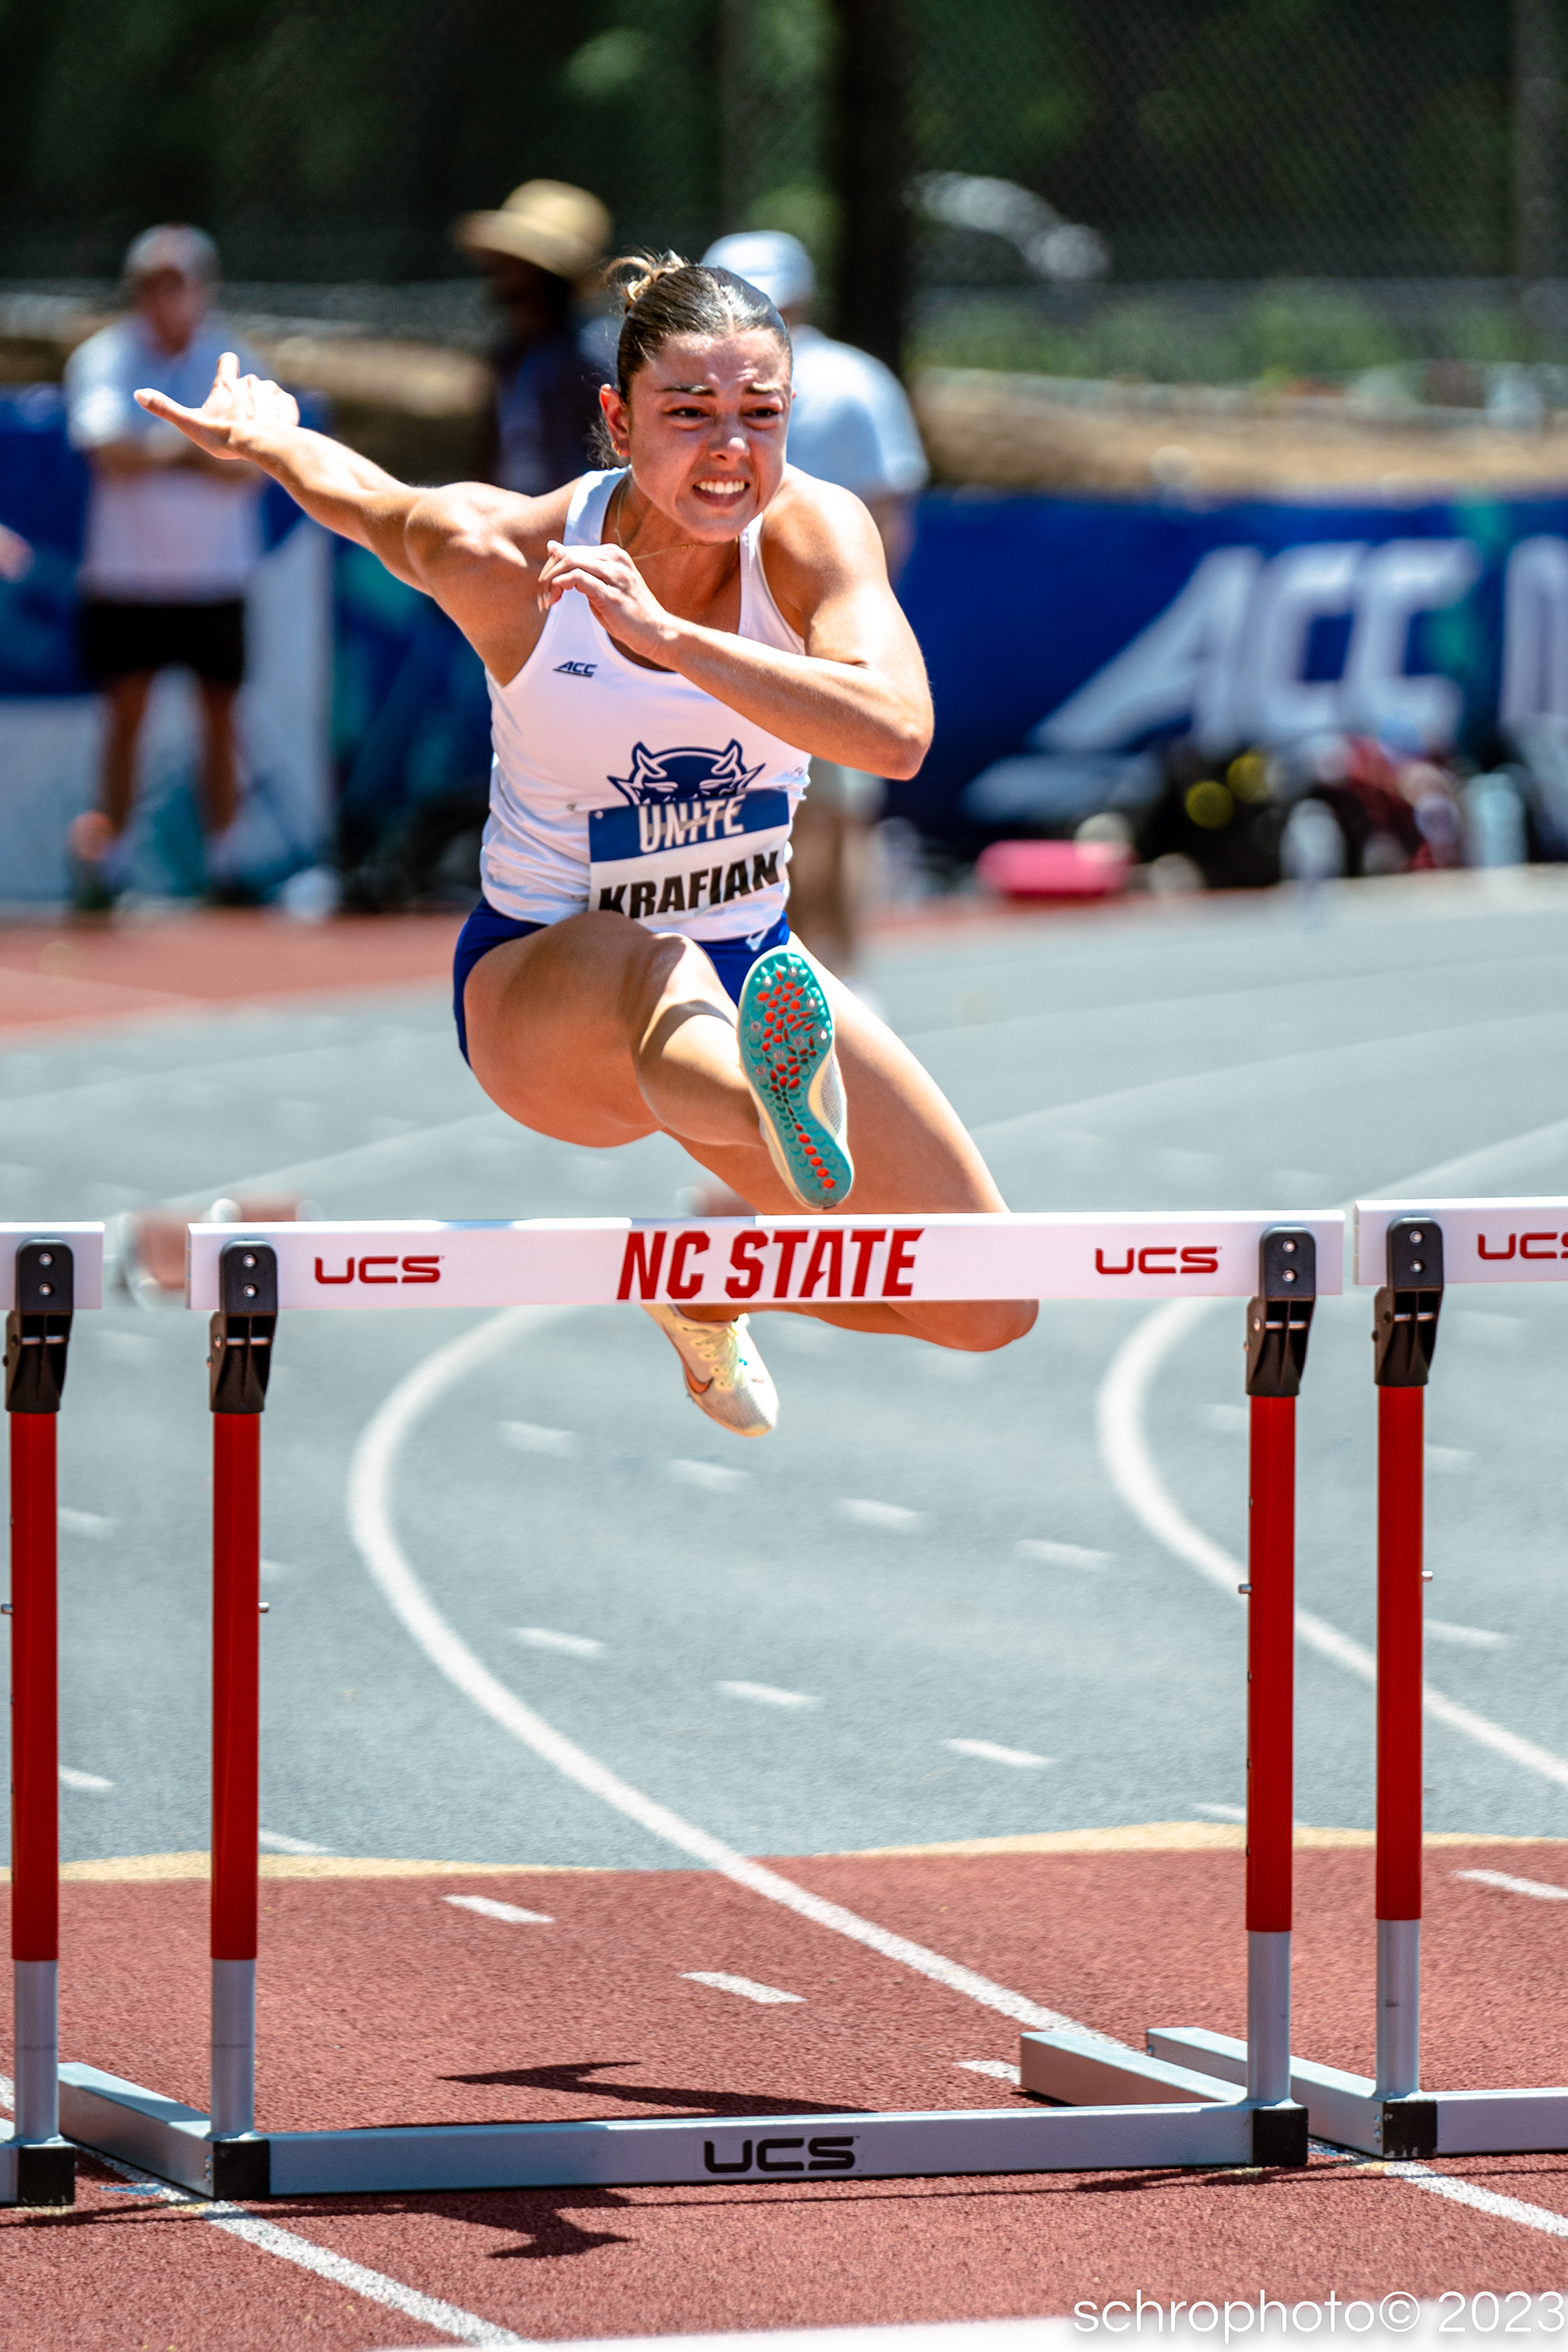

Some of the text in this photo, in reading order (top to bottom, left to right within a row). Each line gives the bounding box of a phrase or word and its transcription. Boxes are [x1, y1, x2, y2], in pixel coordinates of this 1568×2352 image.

[1027, 541, 1478, 743] ACC
[557, 661, 598, 675] ACC
[638, 793, 746, 853] UNITE
[599, 849, 780, 919] KRAFIAN
[617, 1227, 924, 1300] NC STATE
[1095, 1245, 1219, 1275] UCS
[1477, 1232, 1568, 1259] UC
[314, 1255, 440, 1284] UCS
[704, 2136, 856, 2173] UCS
